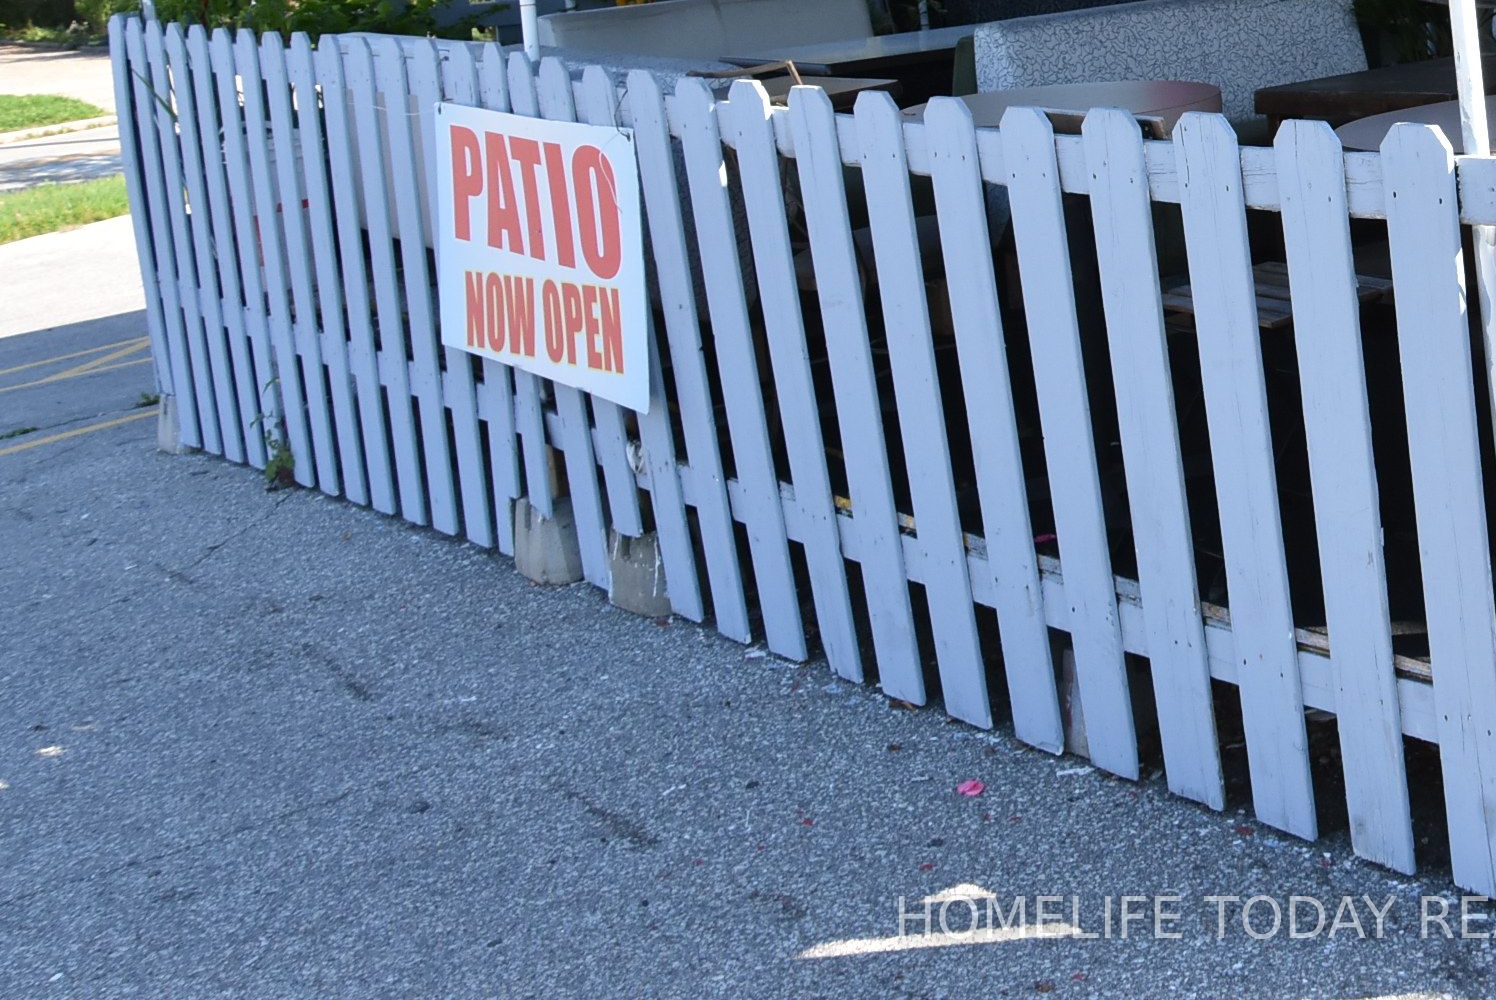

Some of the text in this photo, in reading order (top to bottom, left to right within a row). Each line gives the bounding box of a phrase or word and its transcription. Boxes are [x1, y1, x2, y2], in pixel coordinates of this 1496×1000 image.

[449, 124, 623, 280] PATIO
[464, 269, 625, 376] NOW OPEN
